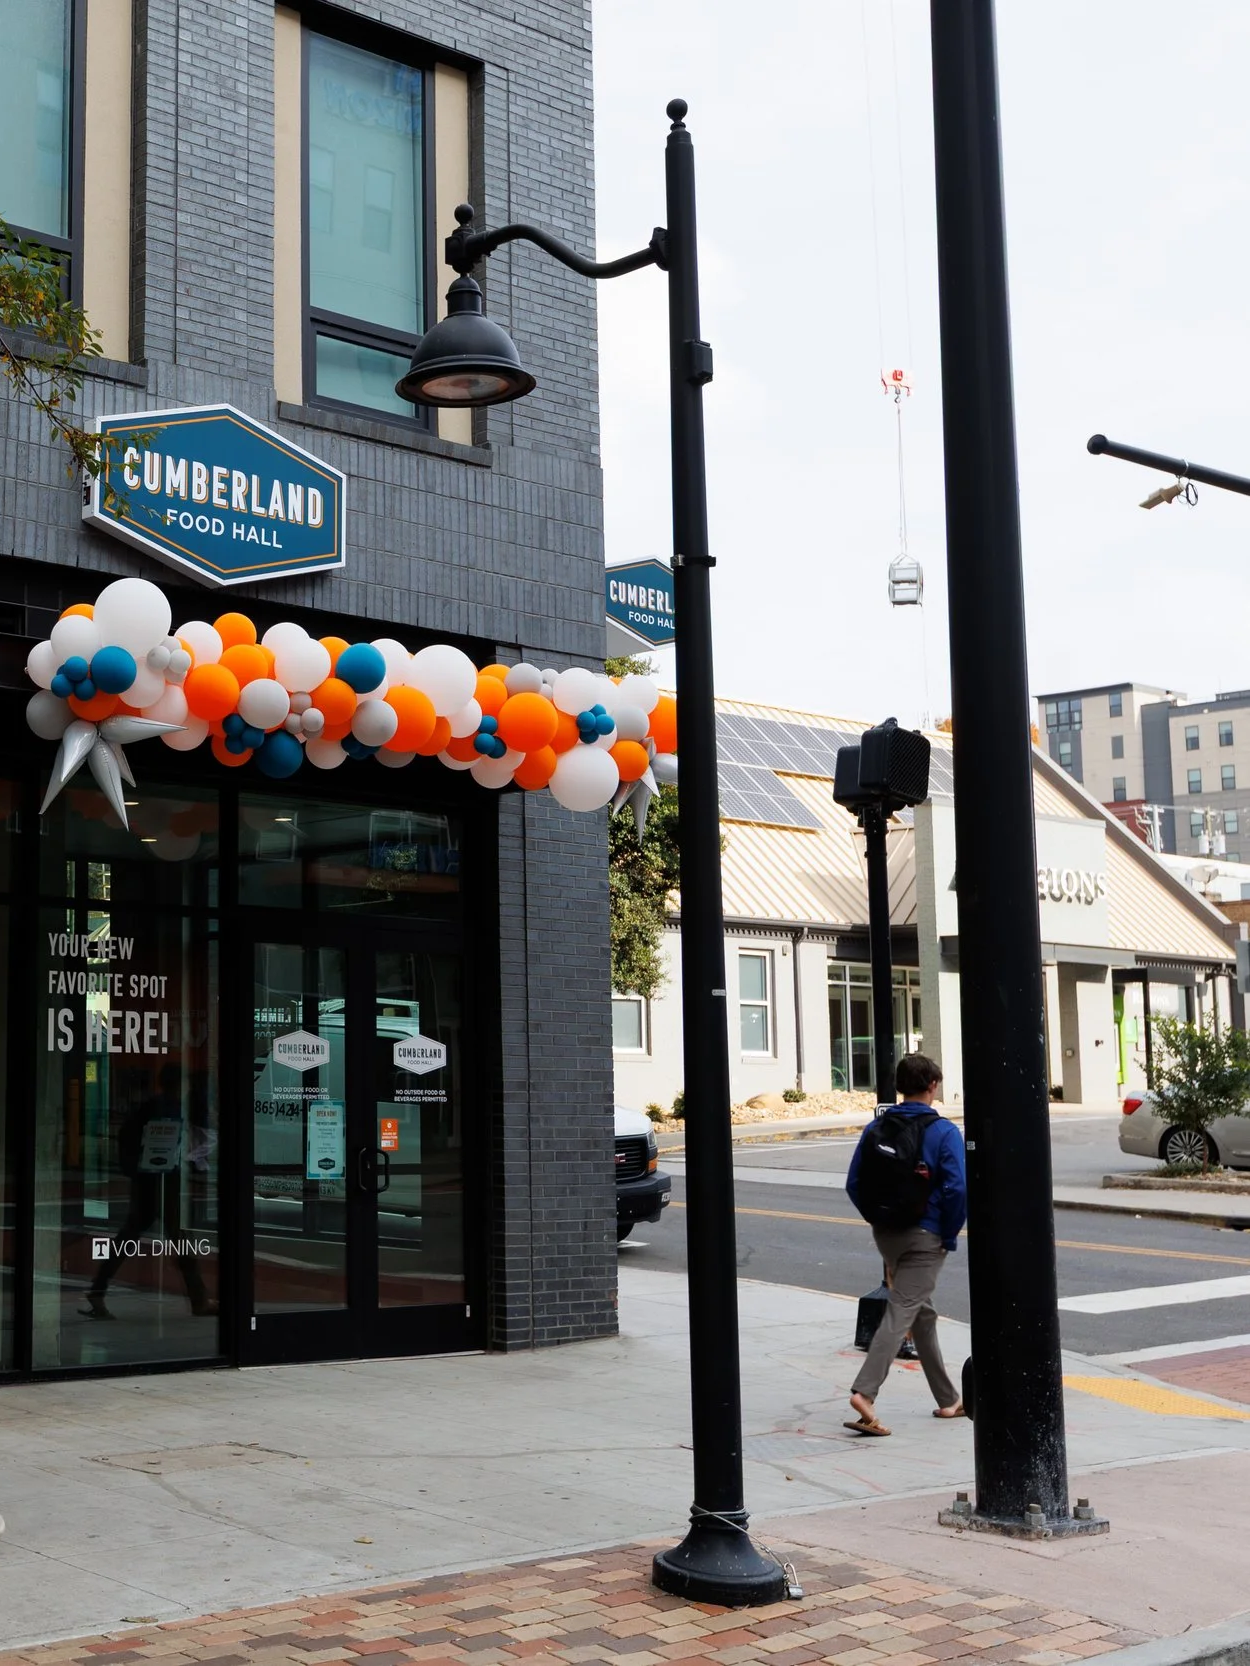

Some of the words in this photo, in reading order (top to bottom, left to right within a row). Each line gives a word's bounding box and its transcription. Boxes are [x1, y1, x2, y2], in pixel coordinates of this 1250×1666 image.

[123, 446, 325, 528] CUMBERLAND
[166, 509, 225, 536] FOOD
[232, 522, 283, 549] HALL
[609, 579, 675, 615] CUMBERL
[628, 611, 655, 625] FOOD
[657, 616, 675, 630] HAL
[1038, 868, 1107, 899] GIONS
[48, 932, 89, 958] YOUR
[97, 936, 135, 960] NEW
[48, 970, 124, 997] FAVORITE
[129, 974, 168, 999] SPOT
[47, 1007, 74, 1053] IS
[86, 1009, 169, 1055] HERE!
[278, 1043, 325, 1055] CUMBERLAND
[398, 1047, 442, 1059] CUMBERLAND
[112, 1239, 147, 1257] VOL
[152, 1238, 211, 1256] DINING
